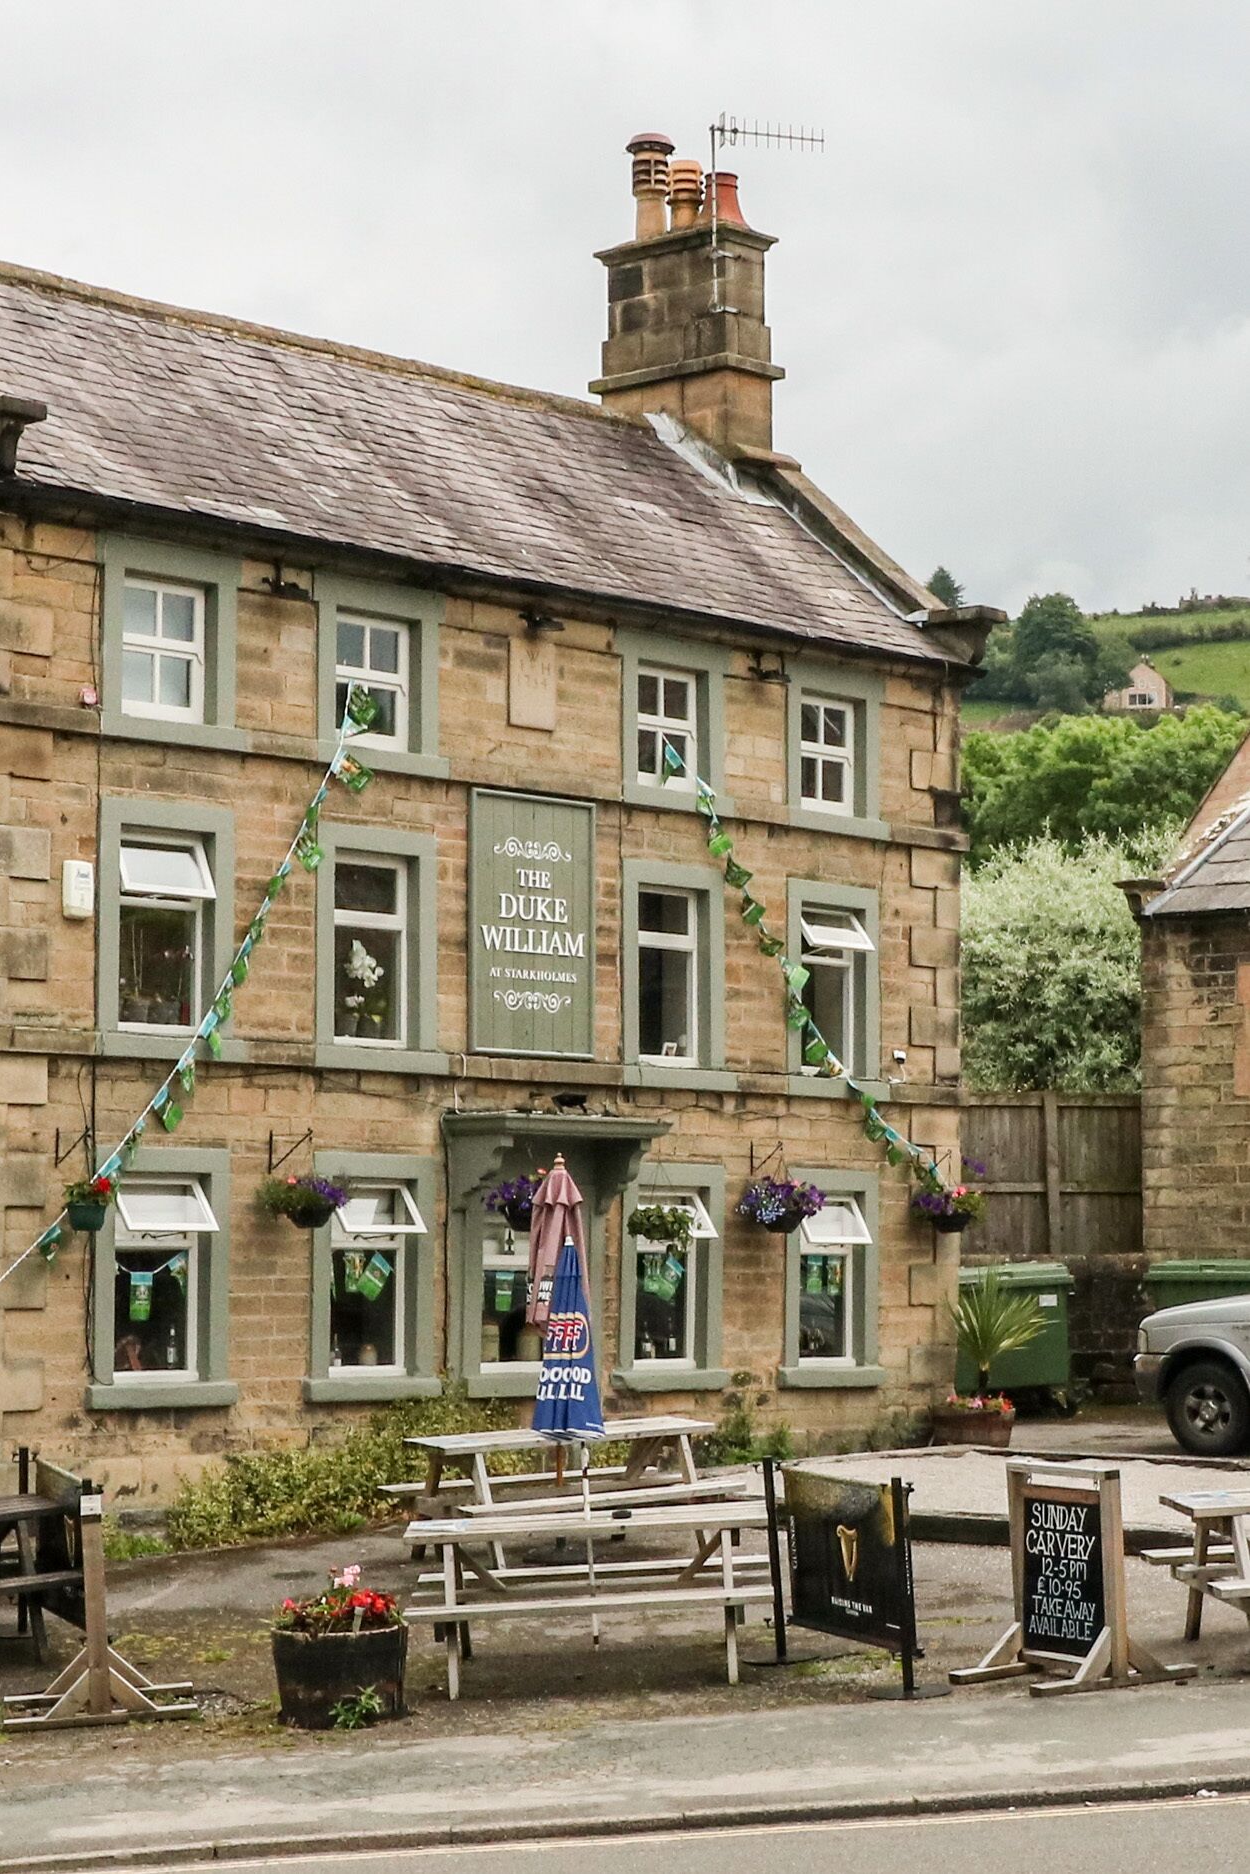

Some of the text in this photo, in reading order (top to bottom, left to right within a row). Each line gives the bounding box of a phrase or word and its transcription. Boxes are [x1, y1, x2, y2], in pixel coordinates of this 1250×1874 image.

[516, 869, 551, 889] THE
[499, 893, 568, 924] DUKE
[481, 925, 585, 958] WILLIAM
[490, 967, 577, 983] AT STARKHOLMES
[1031, 1502, 1088, 1532] SUNDAY
[1026, 1529, 1095, 1560] CARVERY
[1032, 1595, 1096, 1621] TAKEAWAY
[1029, 1614, 1093, 1641] AVAILABLE
